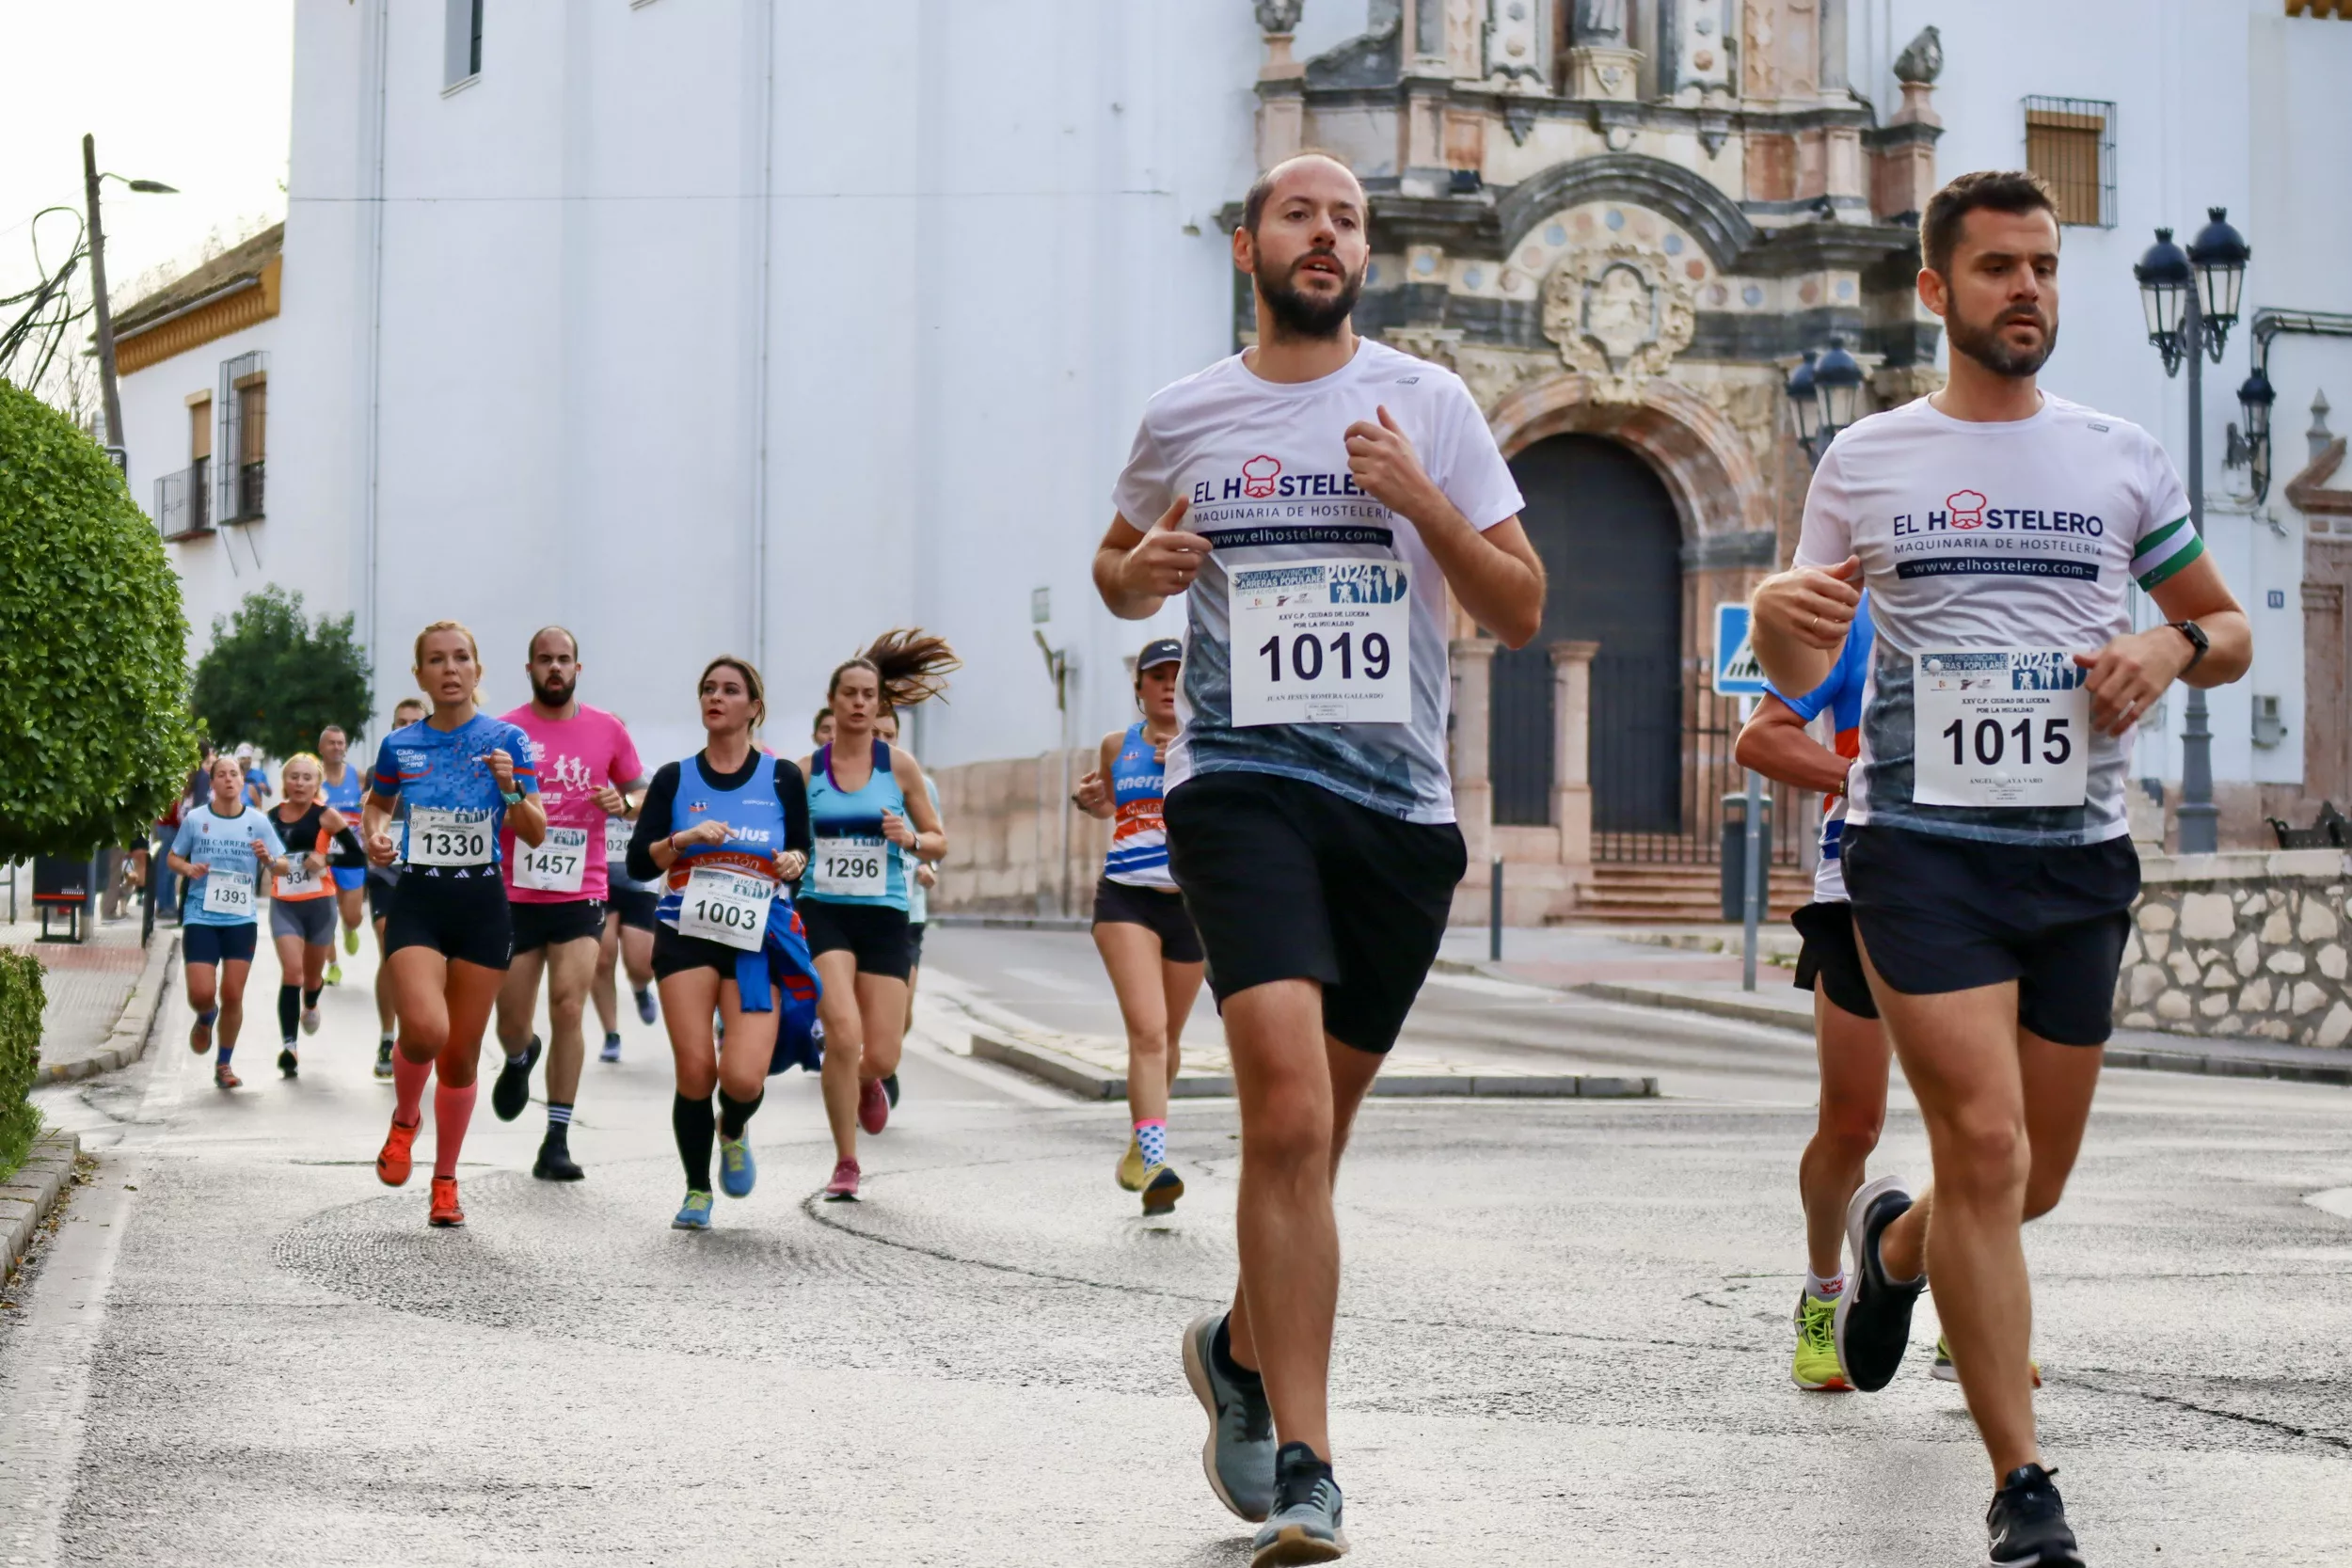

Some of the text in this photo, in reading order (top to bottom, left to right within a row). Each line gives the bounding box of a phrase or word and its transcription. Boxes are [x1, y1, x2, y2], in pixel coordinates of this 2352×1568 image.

[1194, 482, 1216, 503] EL
[1194, 505, 1394, 524] MAQUINARIA DE HOSTELERÍA
[1894, 515, 1920, 536] EL
[1212, 528, 1377, 546] www.elhostelero.com
[1894, 538, 2103, 556] MAQUINARIA DE HOSTELERÍA
[1270, 567, 1313, 579] PROVINCIAL
[1329, 564, 1373, 583] 2024
[1914, 560, 2083, 576] www.elhostelero.com
[1280, 575, 1326, 586] POPULARES
[1260, 632, 1391, 682] 1019
[1963, 660, 2009, 671] POPULARES
[2010, 653, 2054, 671] 2024
[1944, 719, 2071, 765] 1015
[422, 833, 484, 856] 1330
[524, 853, 578, 875] 1457
[826, 857, 879, 878] 1296
[214, 888, 246, 904] 1393
[695, 899, 756, 930] 1003
